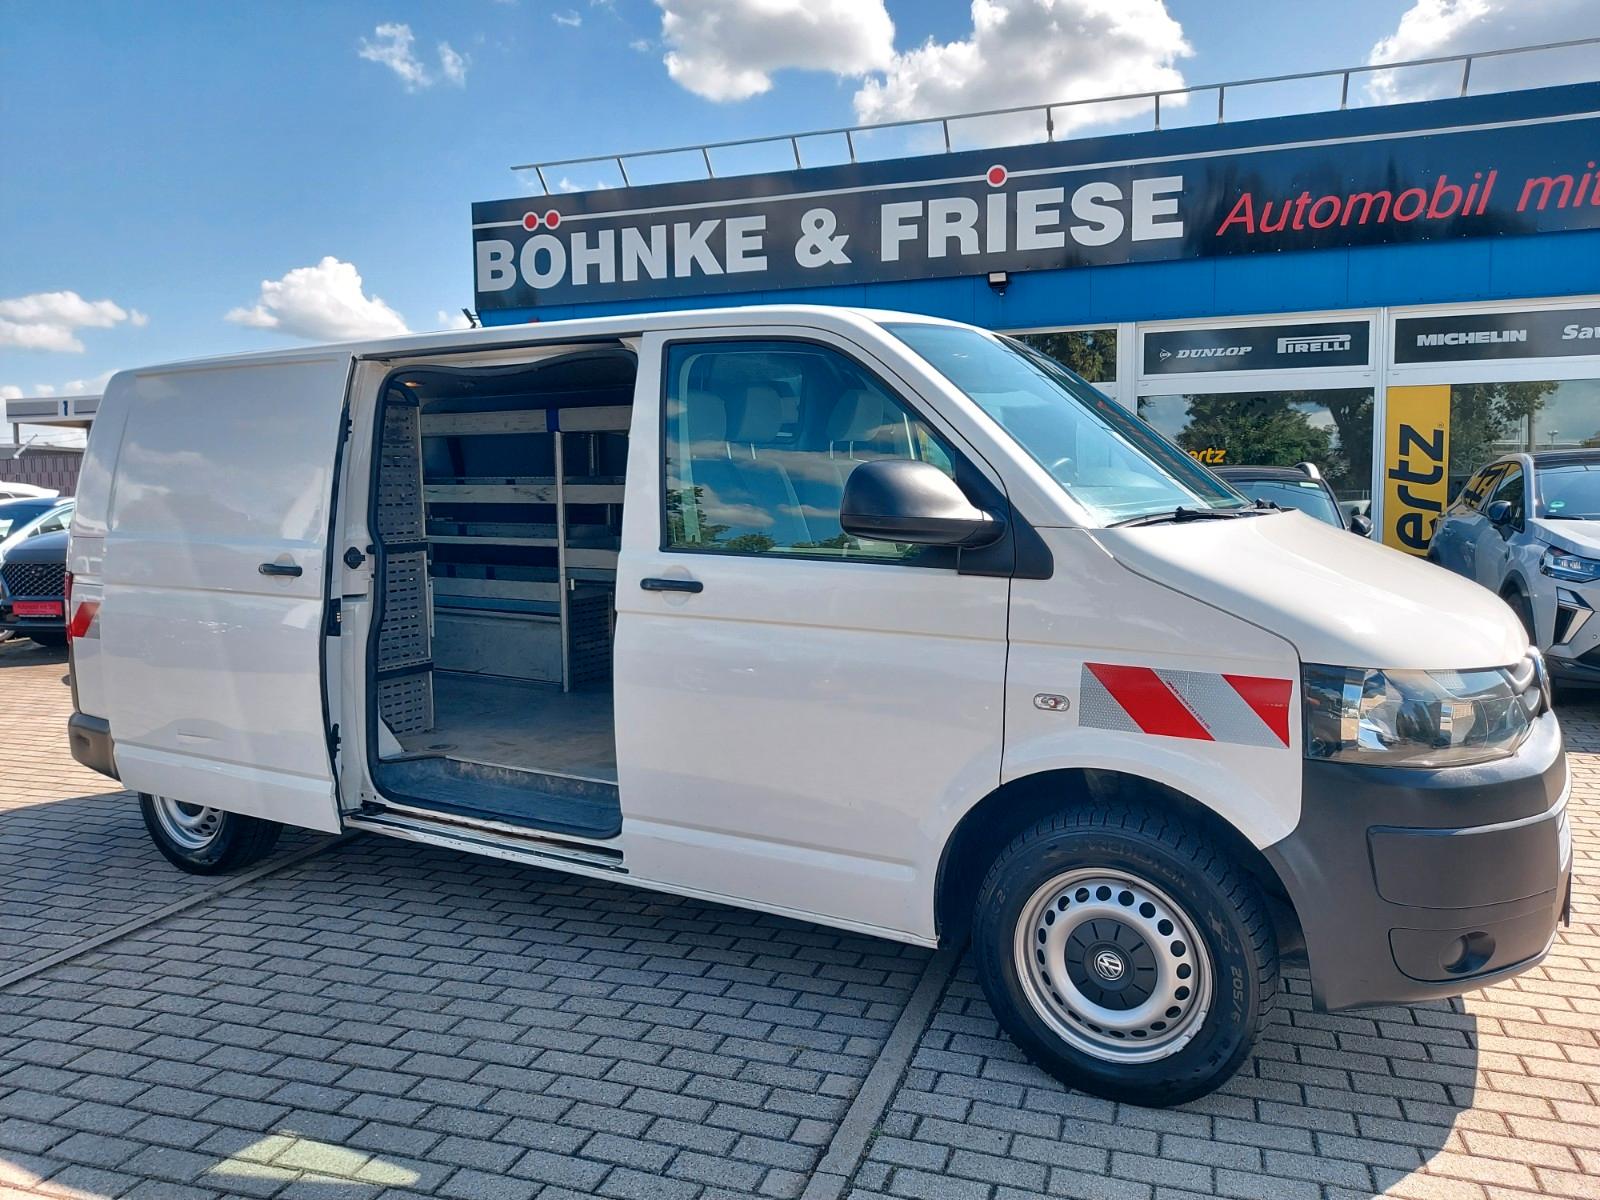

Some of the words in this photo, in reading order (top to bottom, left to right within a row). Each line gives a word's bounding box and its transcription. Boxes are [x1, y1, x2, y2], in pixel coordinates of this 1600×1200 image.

[1216, 169, 1498, 236] Automobil
[476, 209, 768, 293] BÖHNKE
[795, 207, 852, 268] &
[881, 164, 1184, 262] FRIESE
[1276, 334, 1352, 354] PIRELLI
[1416, 329, 1527, 347] MICHELIN
[1175, 346, 1253, 359] DUNLOP
